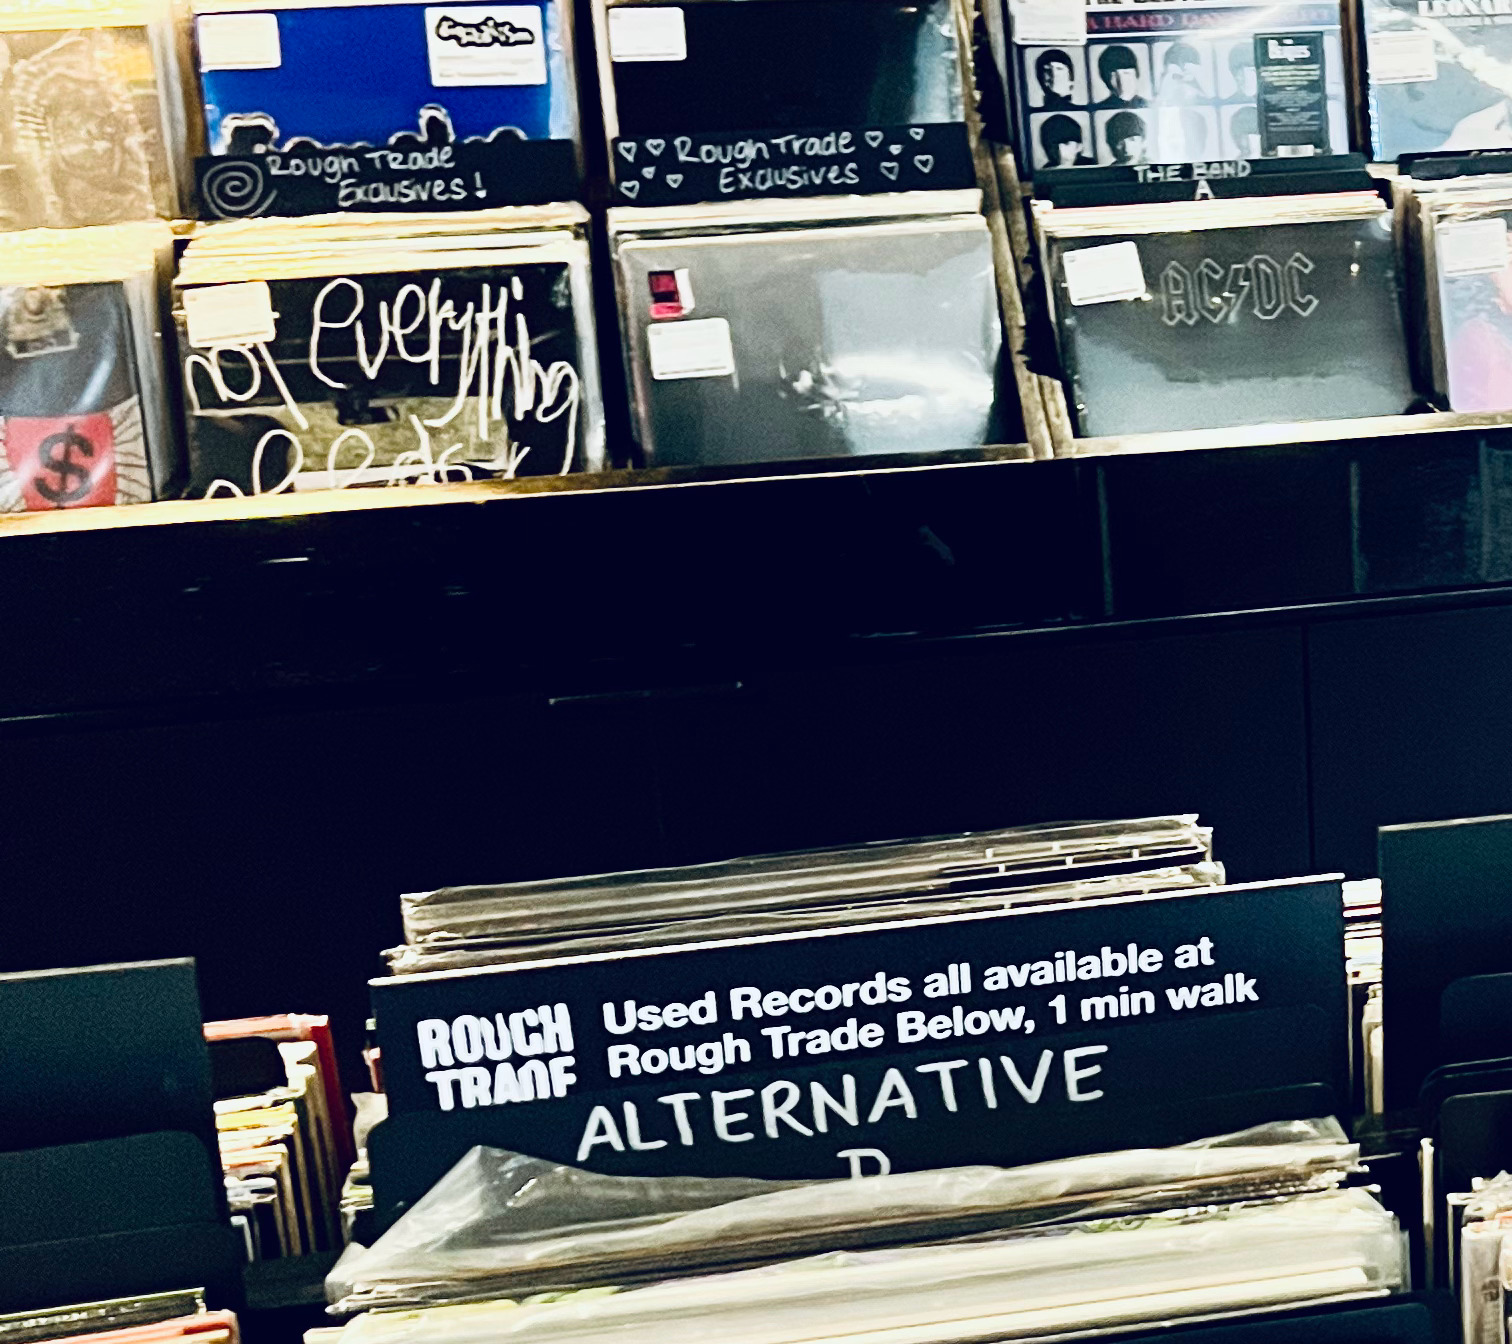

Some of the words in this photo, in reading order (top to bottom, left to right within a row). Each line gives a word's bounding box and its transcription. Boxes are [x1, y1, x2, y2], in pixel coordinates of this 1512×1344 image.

[266, 153, 361, 185] Rough
[365, 145, 456, 172] Trade
[675, 136, 770, 164] Rough
[771, 131, 856, 156] Trade
[1134, 165, 1182, 182] THE
[1193, 160, 1252, 180] BAND
[1195, 180, 1215, 200] A
[1160, 252, 1319, 326] AC/DC
[602, 991, 717, 1037] Used
[729, 971, 911, 1022] Records
[923, 960, 972, 998] all
[983, 937, 1163, 991] available
[1174, 935, 1216, 971] at
[606, 1028, 752, 1081] Rough
[759, 1014, 883, 1063] Trade
[895, 995, 1036, 1048] Below,
[1051, 994, 1069, 1027] 1
[1080, 983, 1157, 1024] min
[1166, 969, 1260, 1012] walk
[575, 1043, 1110, 1163] ALTERNATIVE
